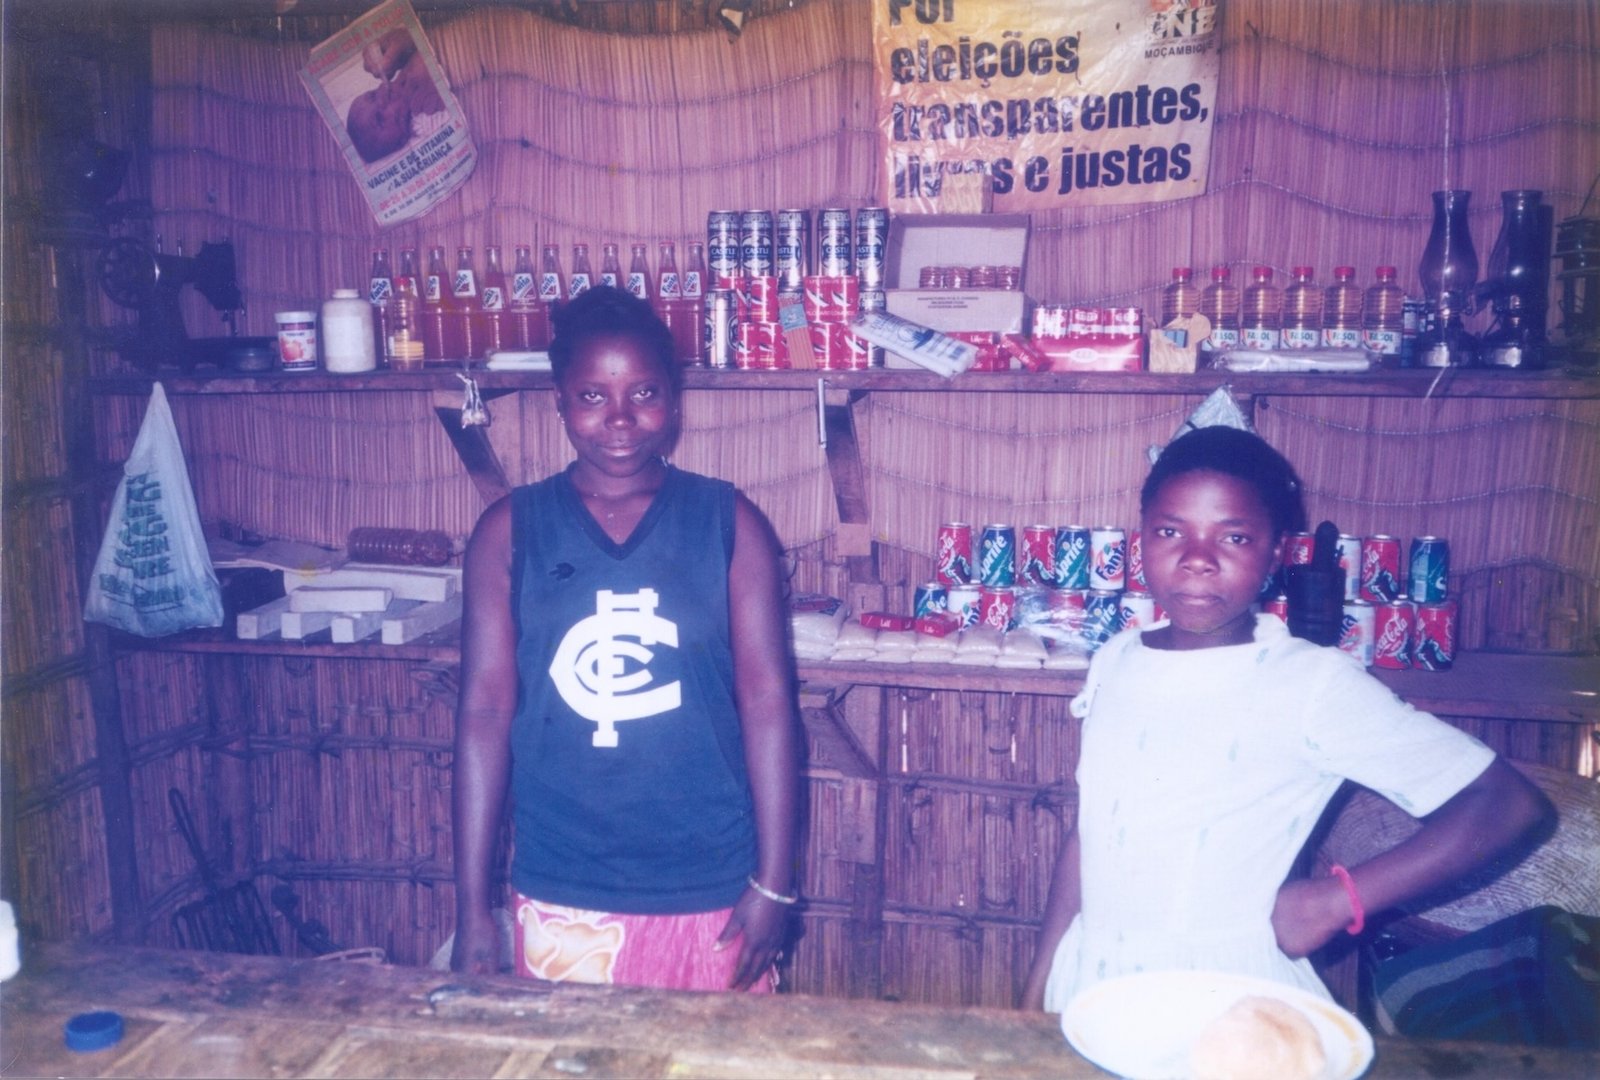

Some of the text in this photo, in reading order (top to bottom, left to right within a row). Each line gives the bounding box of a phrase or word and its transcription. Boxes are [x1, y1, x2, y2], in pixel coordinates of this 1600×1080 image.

[890, 30, 1080, 89] eleições
[891, 83, 1208, 141] transparentes,
[416, 142, 453, 172] CRIANÇA
[417, 125, 455, 156] VITAMINA
[1025, 156, 1049, 193] e
[1058, 142, 1191, 196] justas
[1056, 537, 1085, 583] Sprite
[1095, 539, 1126, 581] Fanta
